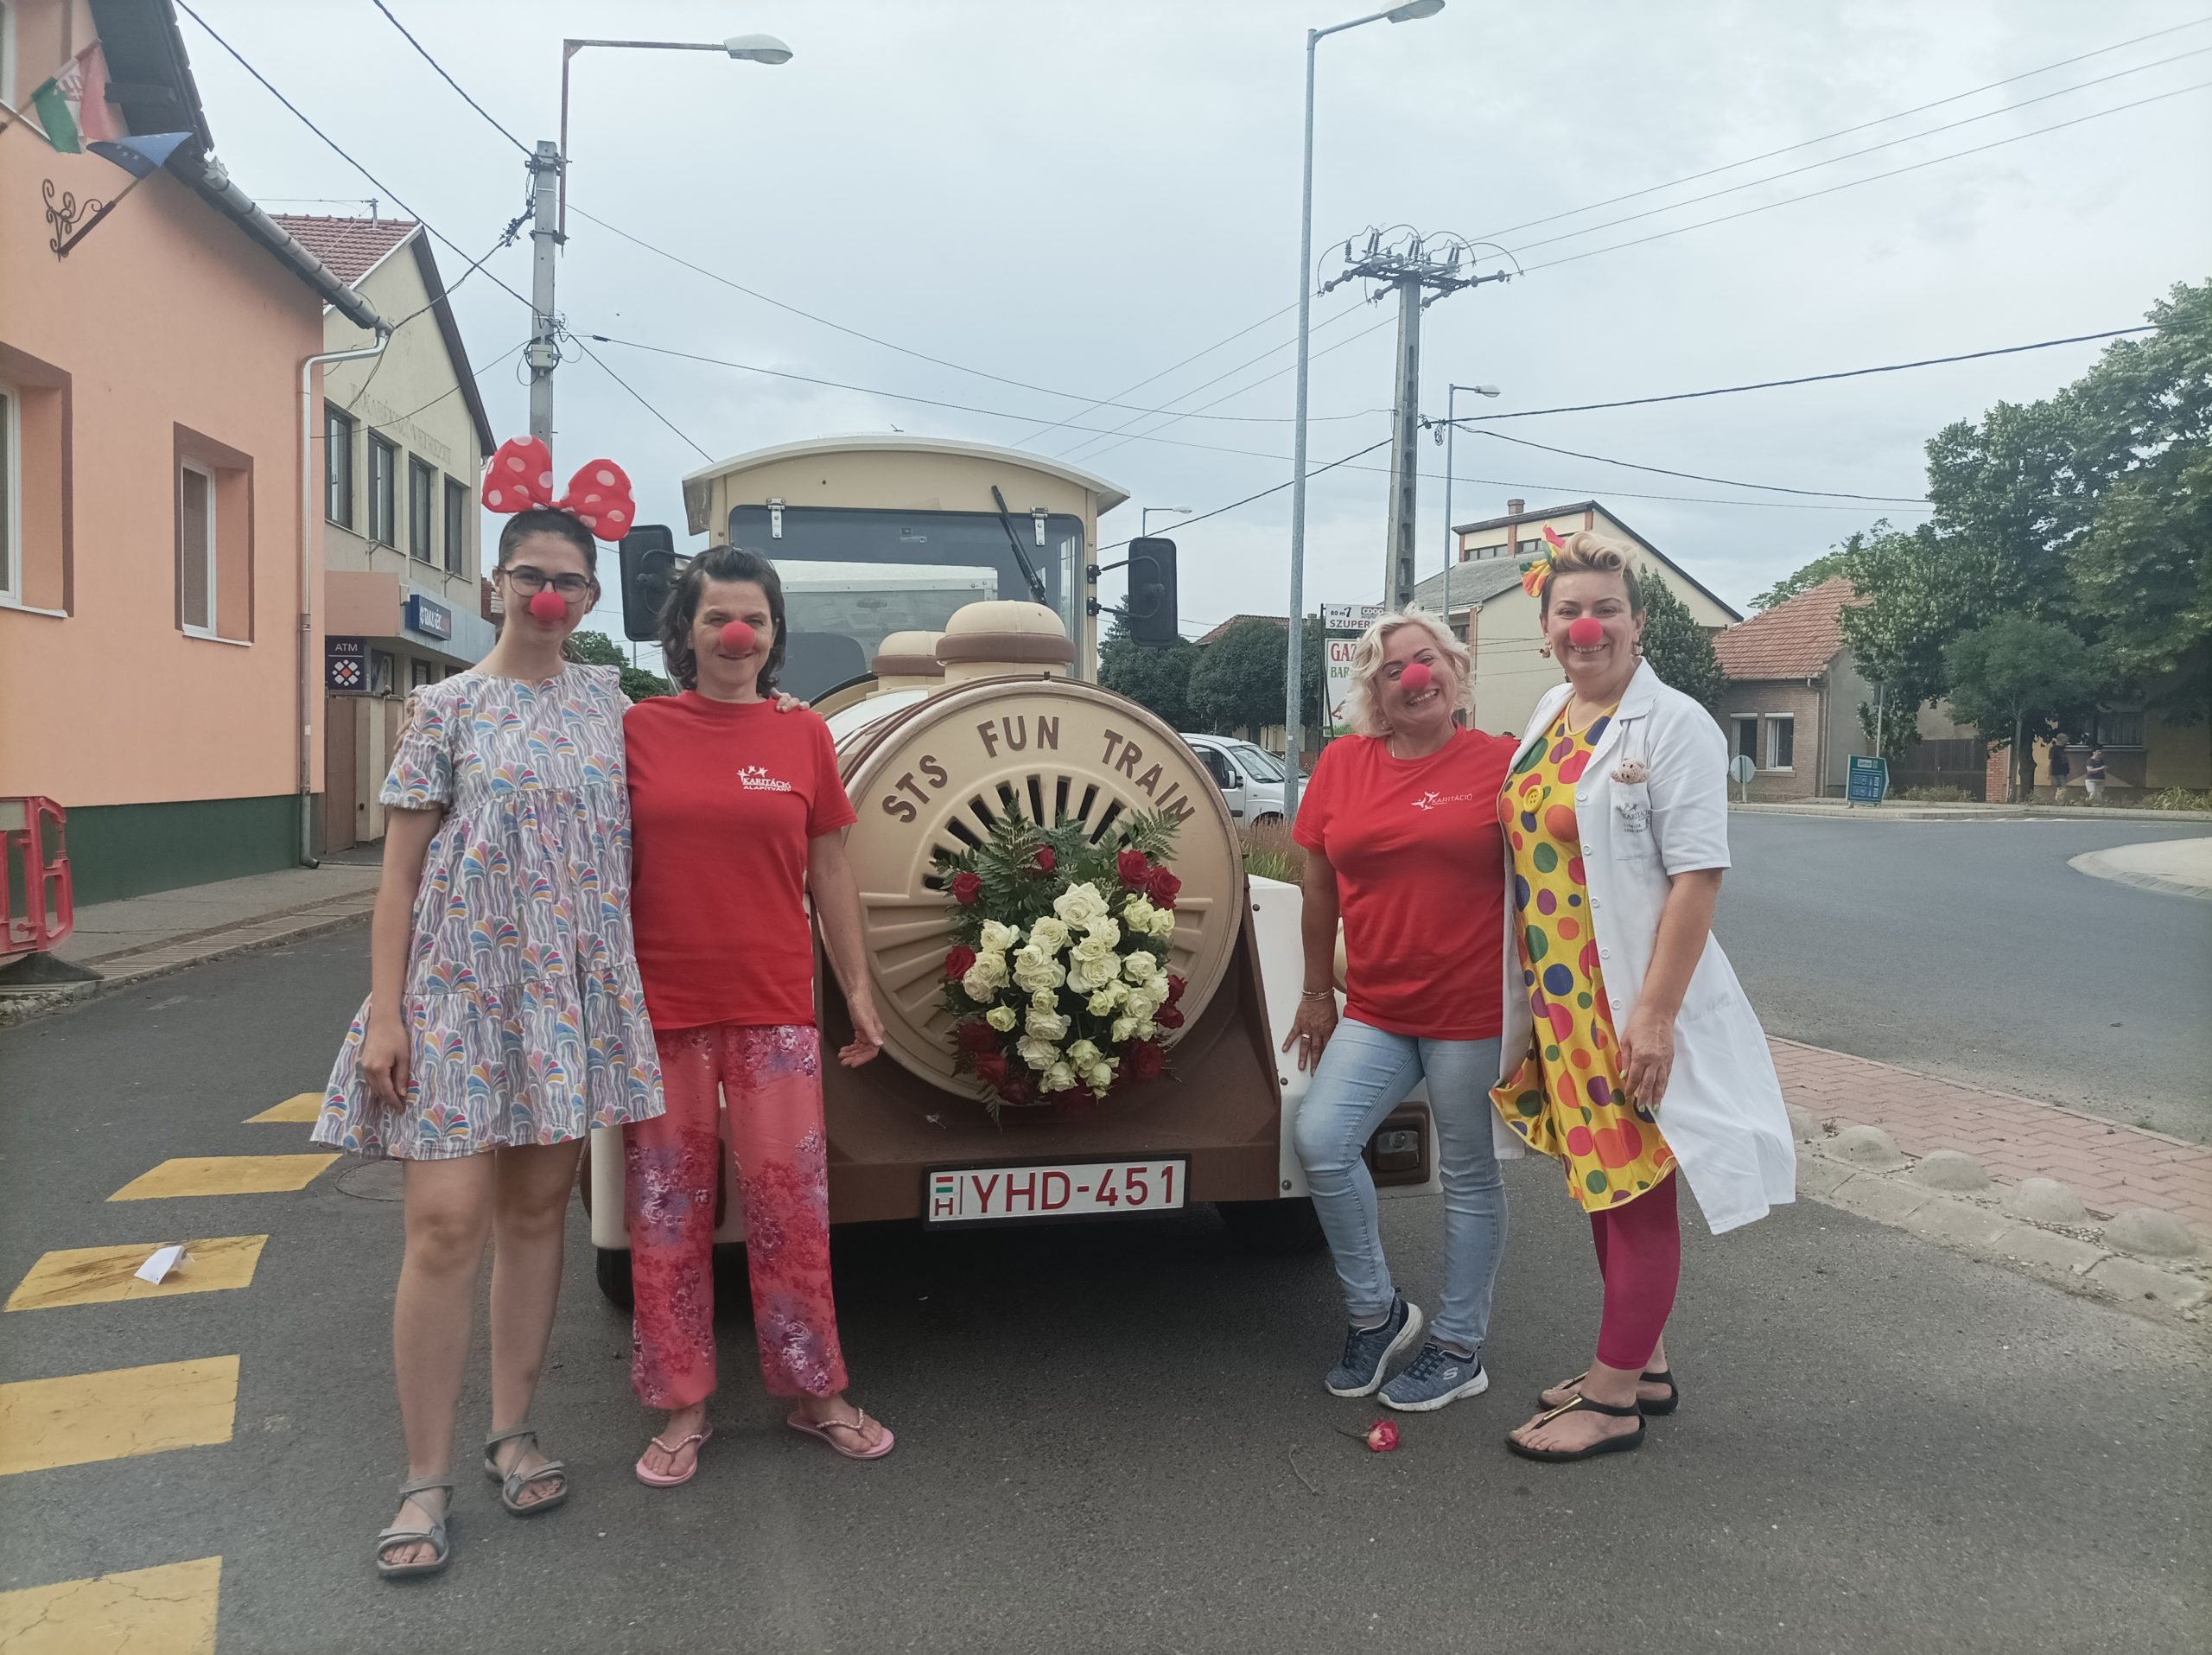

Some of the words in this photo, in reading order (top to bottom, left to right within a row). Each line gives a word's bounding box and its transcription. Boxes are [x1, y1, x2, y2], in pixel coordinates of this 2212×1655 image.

[881, 754, 948, 823] STS
[976, 715, 1059, 758] FUN
[1102, 729, 1196, 824] TRAIN
[934, 1197, 954, 1216] H
[971, 1165, 1173, 1213] YHD-451
